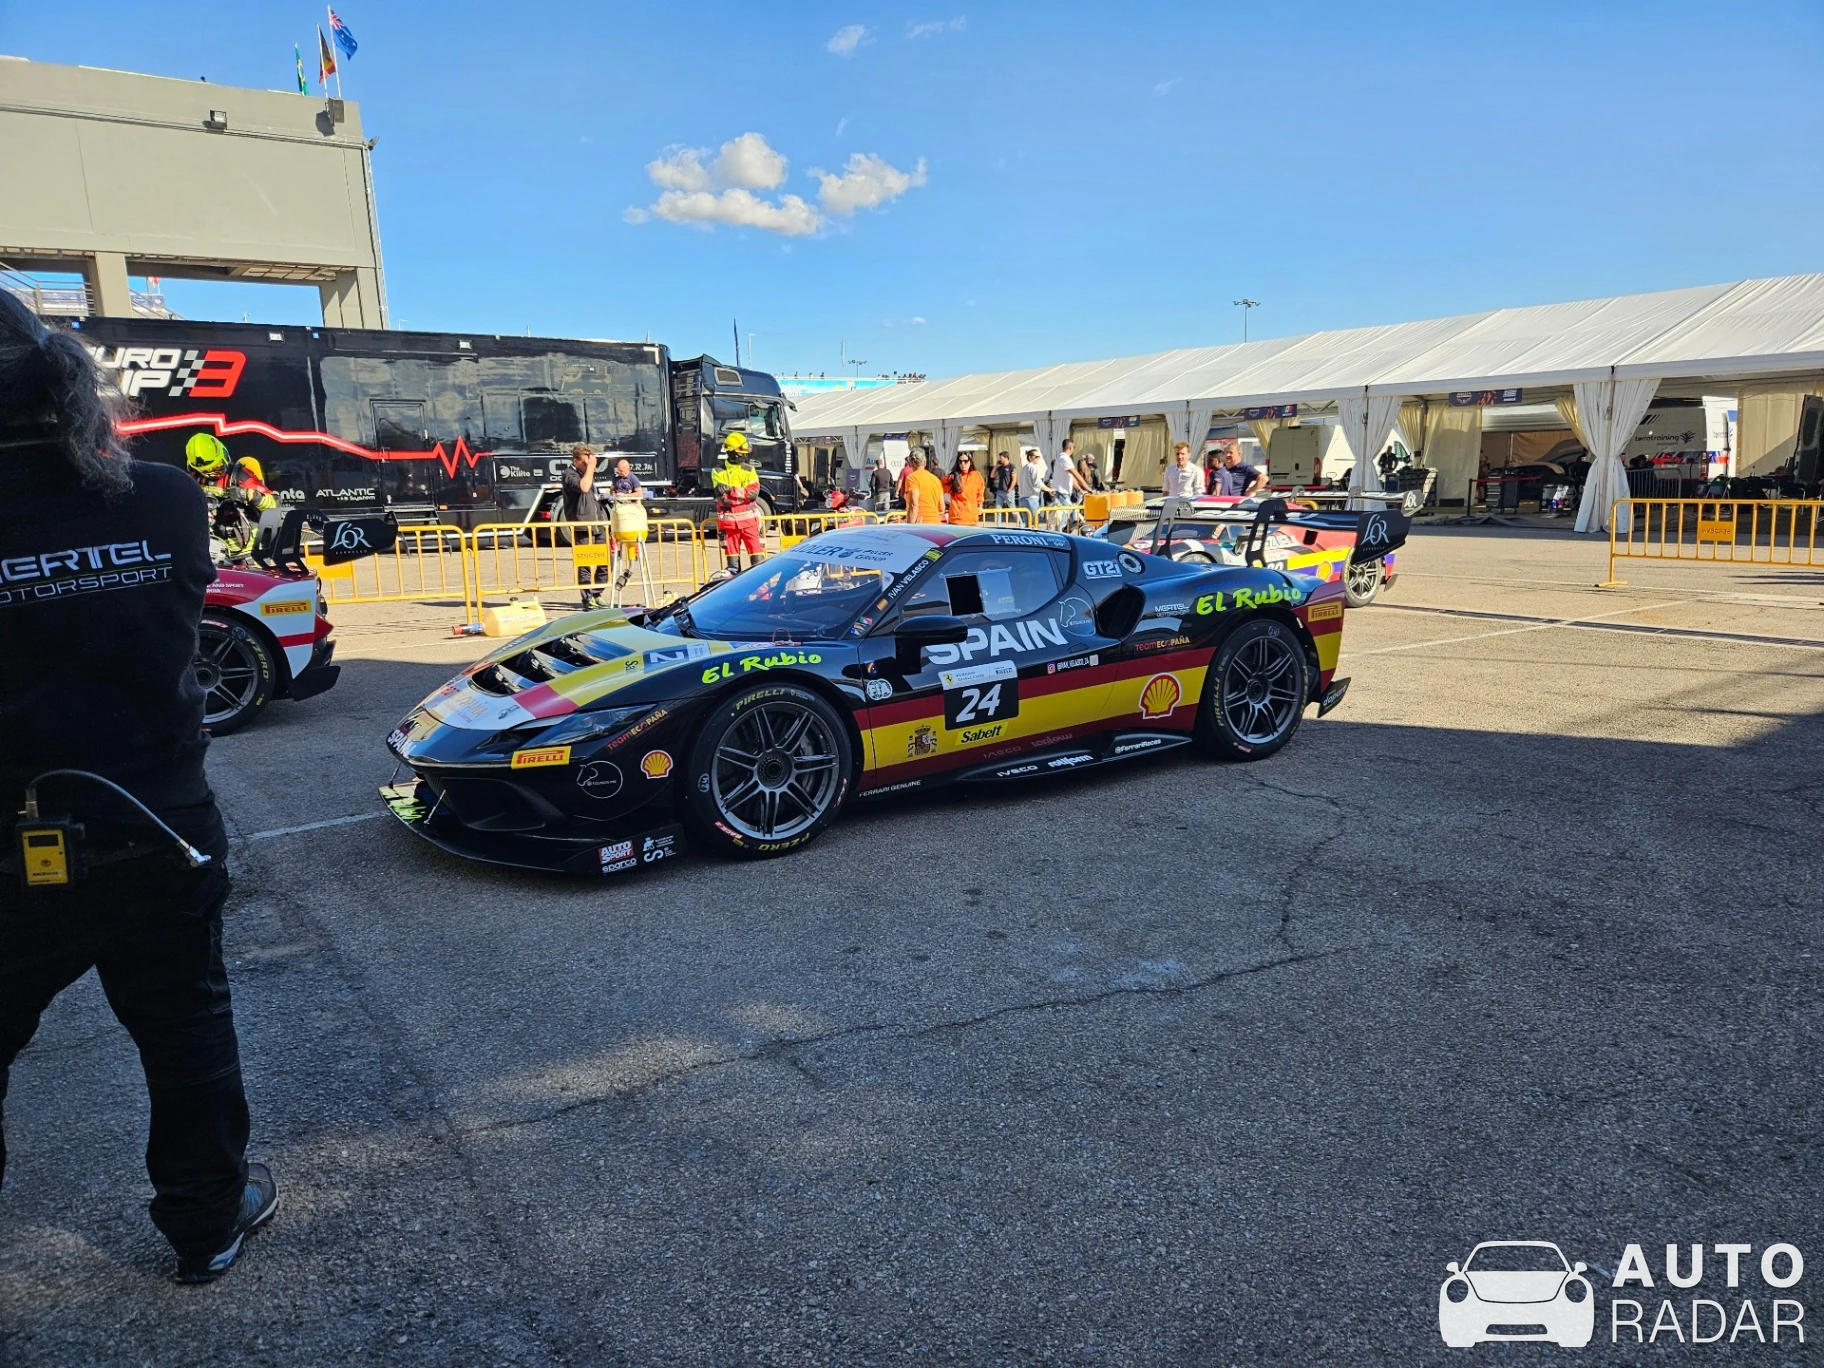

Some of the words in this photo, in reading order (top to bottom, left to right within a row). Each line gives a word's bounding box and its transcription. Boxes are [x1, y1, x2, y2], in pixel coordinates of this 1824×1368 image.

[189, 349, 246, 398] 3
[316, 488, 375, 497] ATLANTIC
[990, 534, 1049, 546] PERONI
[0, 540, 172, 583] ERTEL
[0, 566, 173, 603] OTORSPORT
[887, 581, 905, 599] IVAN
[902, 559, 929, 585] VELASCO
[1233, 582, 1301, 609] Rubio
[265, 602, 307, 614] PIRELLI
[1312, 605, 1339, 619] PIRELLI
[925, 618, 1069, 665] SPAIN
[740, 651, 822, 672] Rubio
[736, 688, 785, 711] PIRELLI
[956, 684, 1002, 723] 24
[961, 726, 1002, 744] Sabelt
[516, 750, 565, 765] PIRELLI
[1048, 754, 1094, 768] rotiform
[997, 764, 1038, 777] IVECO
[859, 784, 890, 798] FERRARI
[890, 779, 922, 791] GENUINE
[601, 841, 632, 856] AUTO
[601, 849, 632, 864] SPORT
